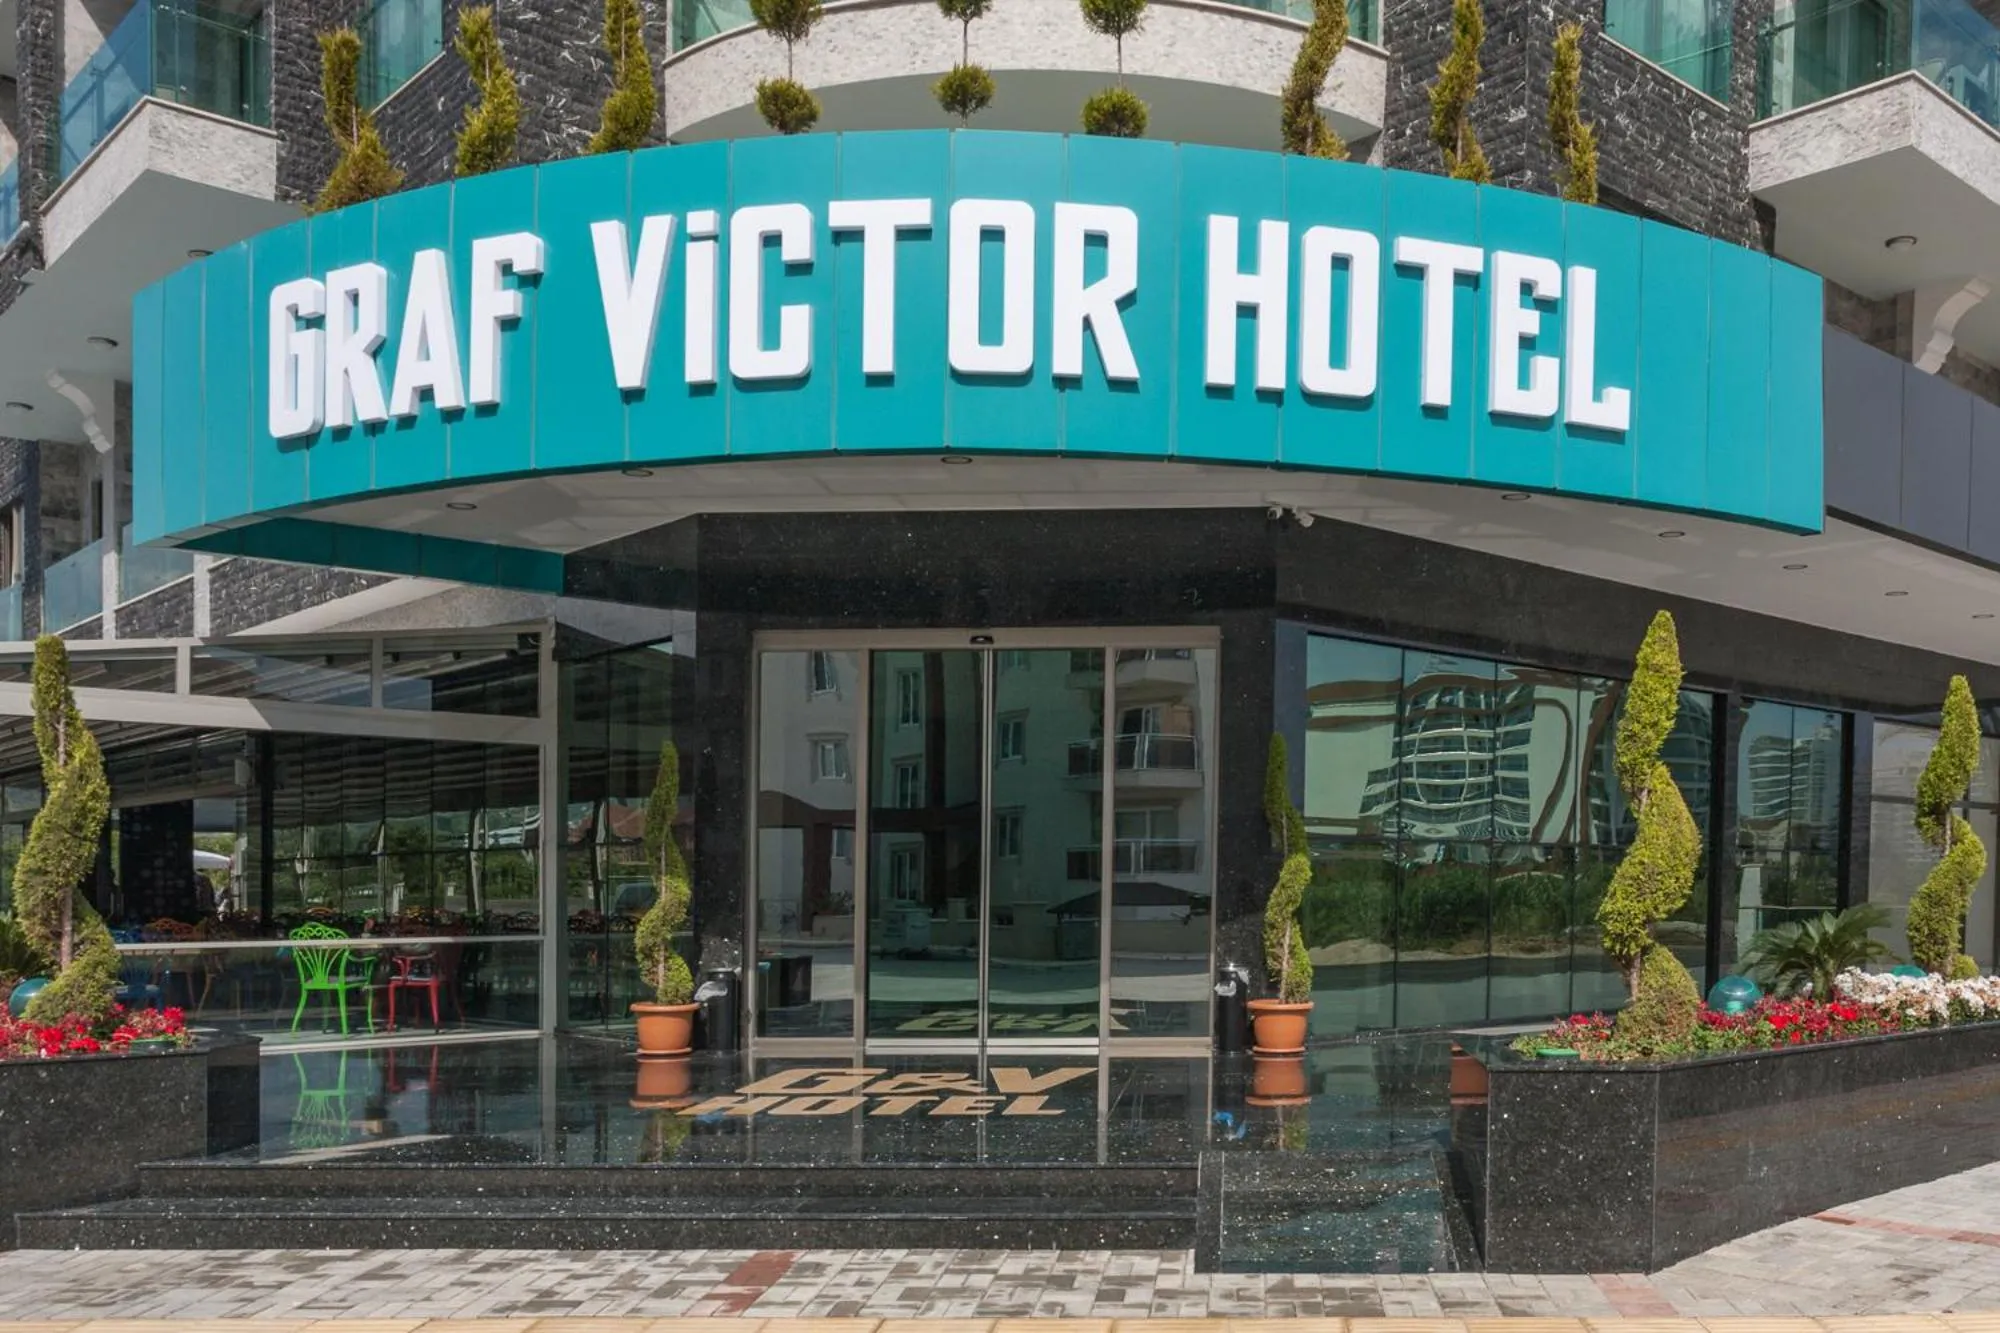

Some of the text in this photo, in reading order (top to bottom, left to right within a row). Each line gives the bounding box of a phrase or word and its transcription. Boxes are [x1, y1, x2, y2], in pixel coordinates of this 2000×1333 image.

[268, 231, 546, 440] GRAF
[1203, 213, 1632, 433] HOTEL
[735, 1067, 1099, 1094] G&V
[676, 1095, 1066, 1116] HOTEL
